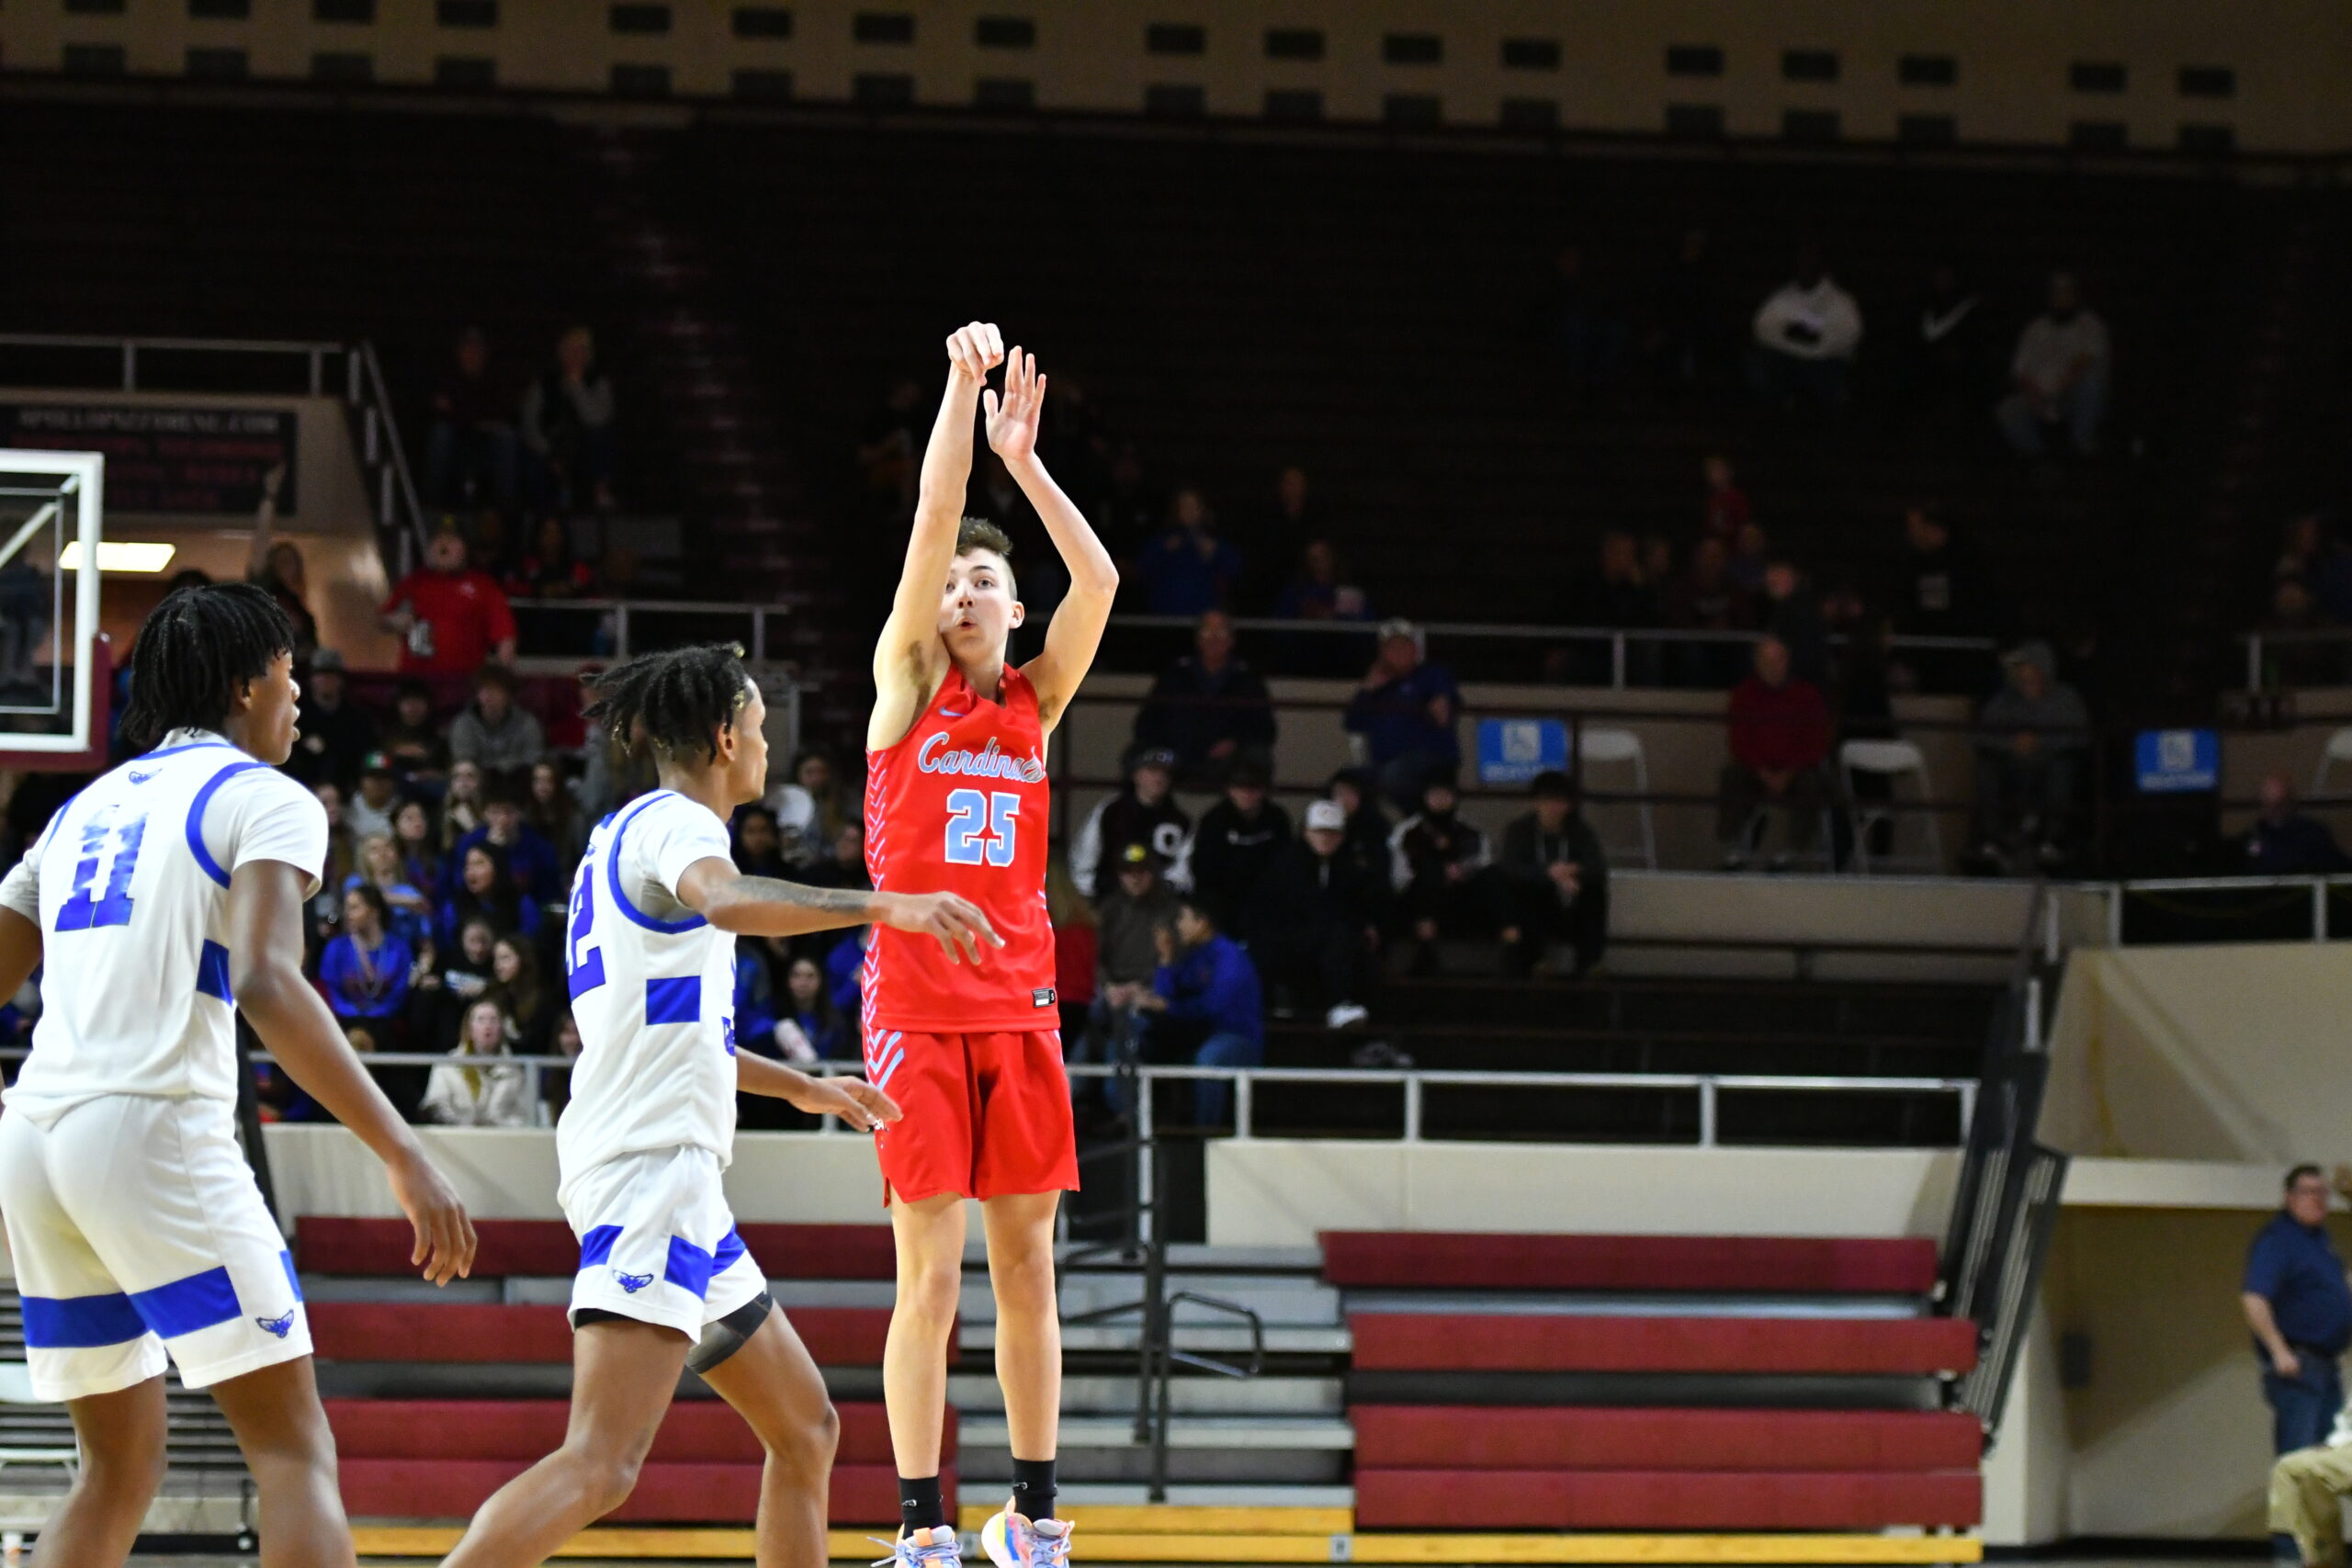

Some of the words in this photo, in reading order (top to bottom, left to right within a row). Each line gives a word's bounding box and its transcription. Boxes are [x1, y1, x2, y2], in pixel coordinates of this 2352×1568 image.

[918, 731, 1046, 784] Cardinas
[54, 803, 149, 931] 11
[944, 788, 1021, 867] 25
[566, 862, 605, 1003] 2
